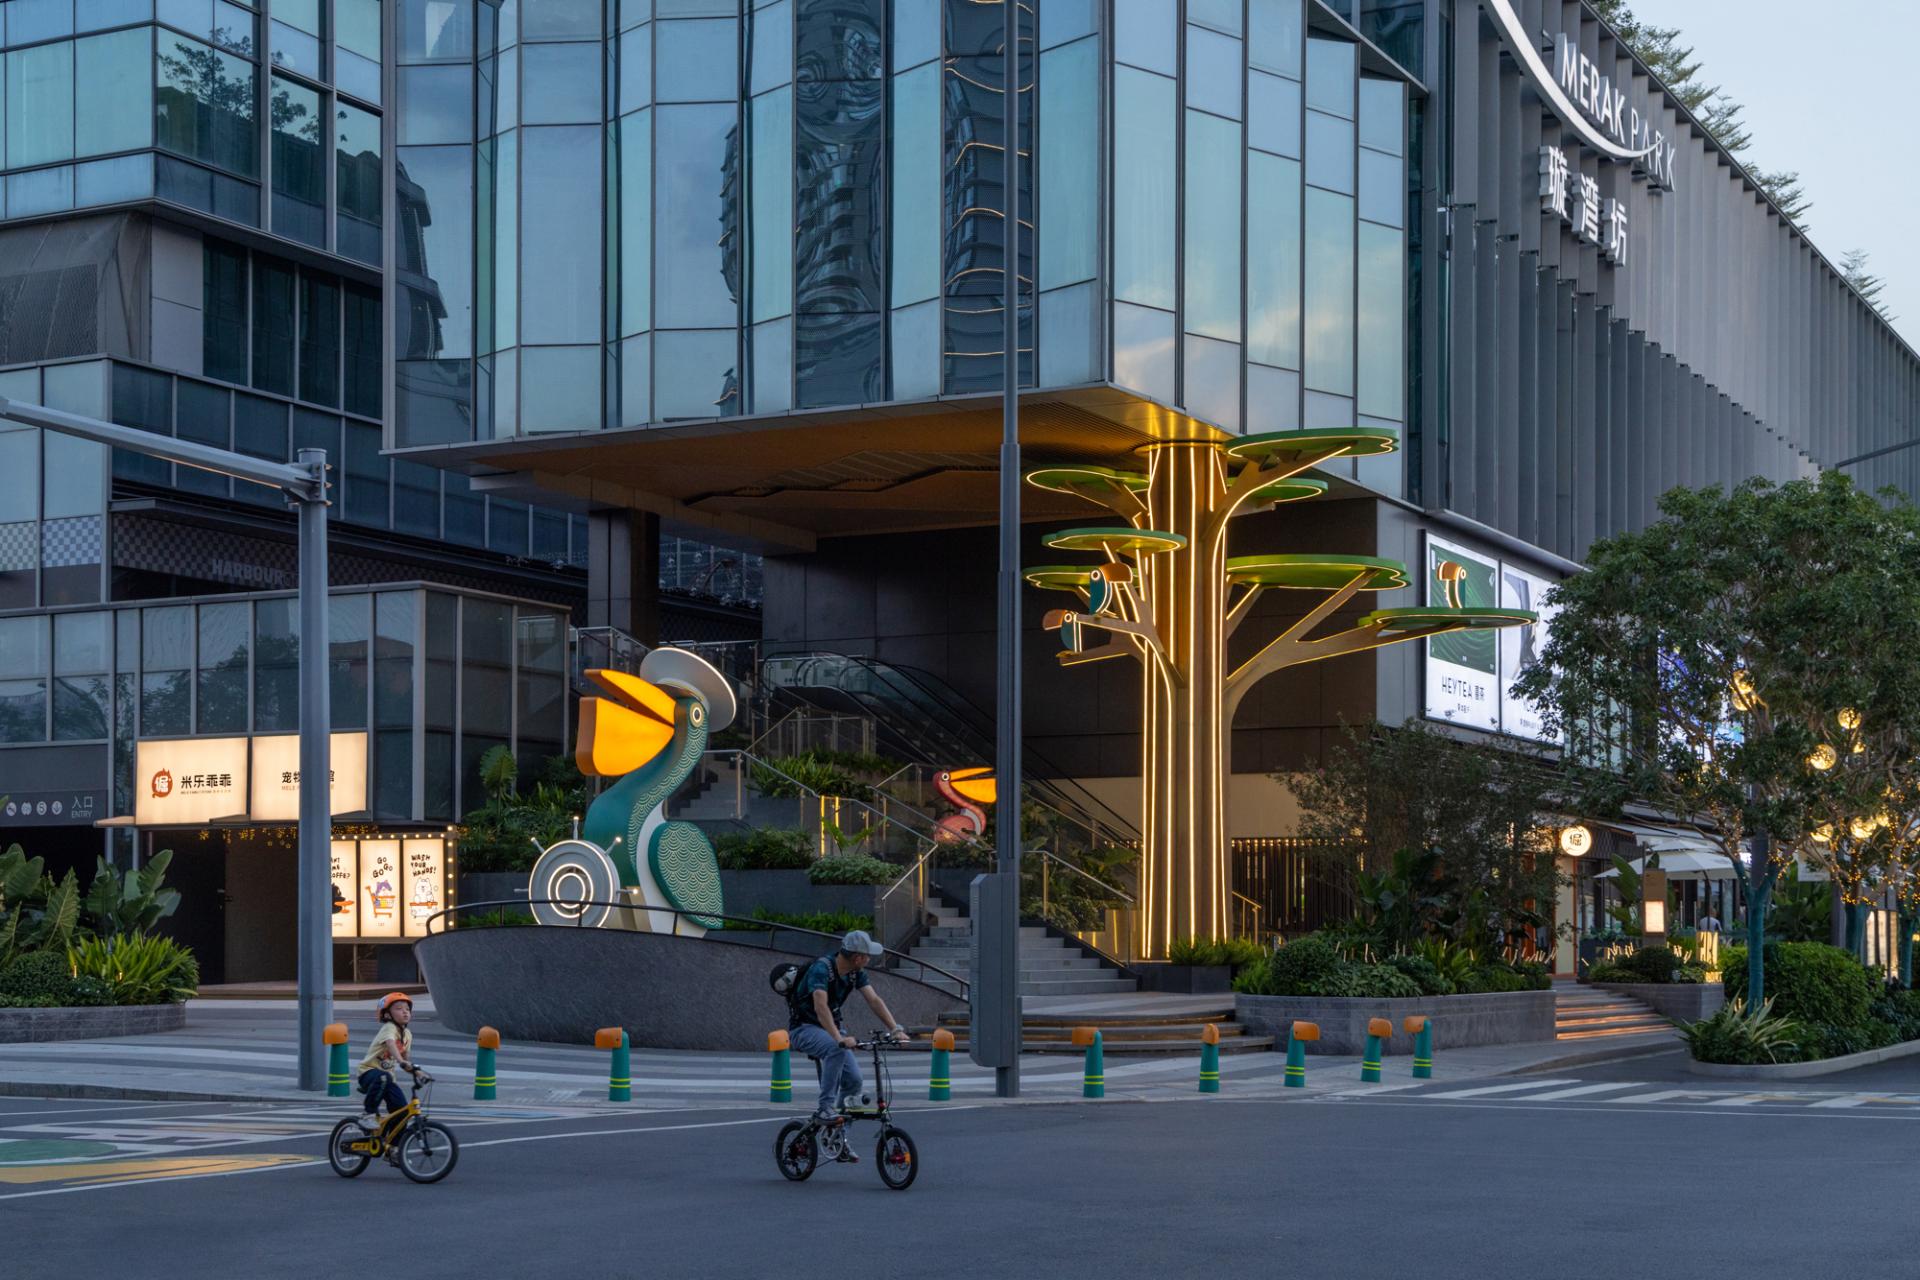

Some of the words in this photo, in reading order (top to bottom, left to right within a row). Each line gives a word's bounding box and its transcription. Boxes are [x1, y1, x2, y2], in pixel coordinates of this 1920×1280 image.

[1561, 32, 1626, 145] MERAK
[1630, 107, 1676, 193] PARK
[1441, 675, 1473, 698] HEYTEA
[180, 773, 232, 789] 米乐乖乖
[72, 795, 93, 809] 入口
[71, 810, 93, 819] ENTRY
[412, 866, 437, 877] HANDS!
